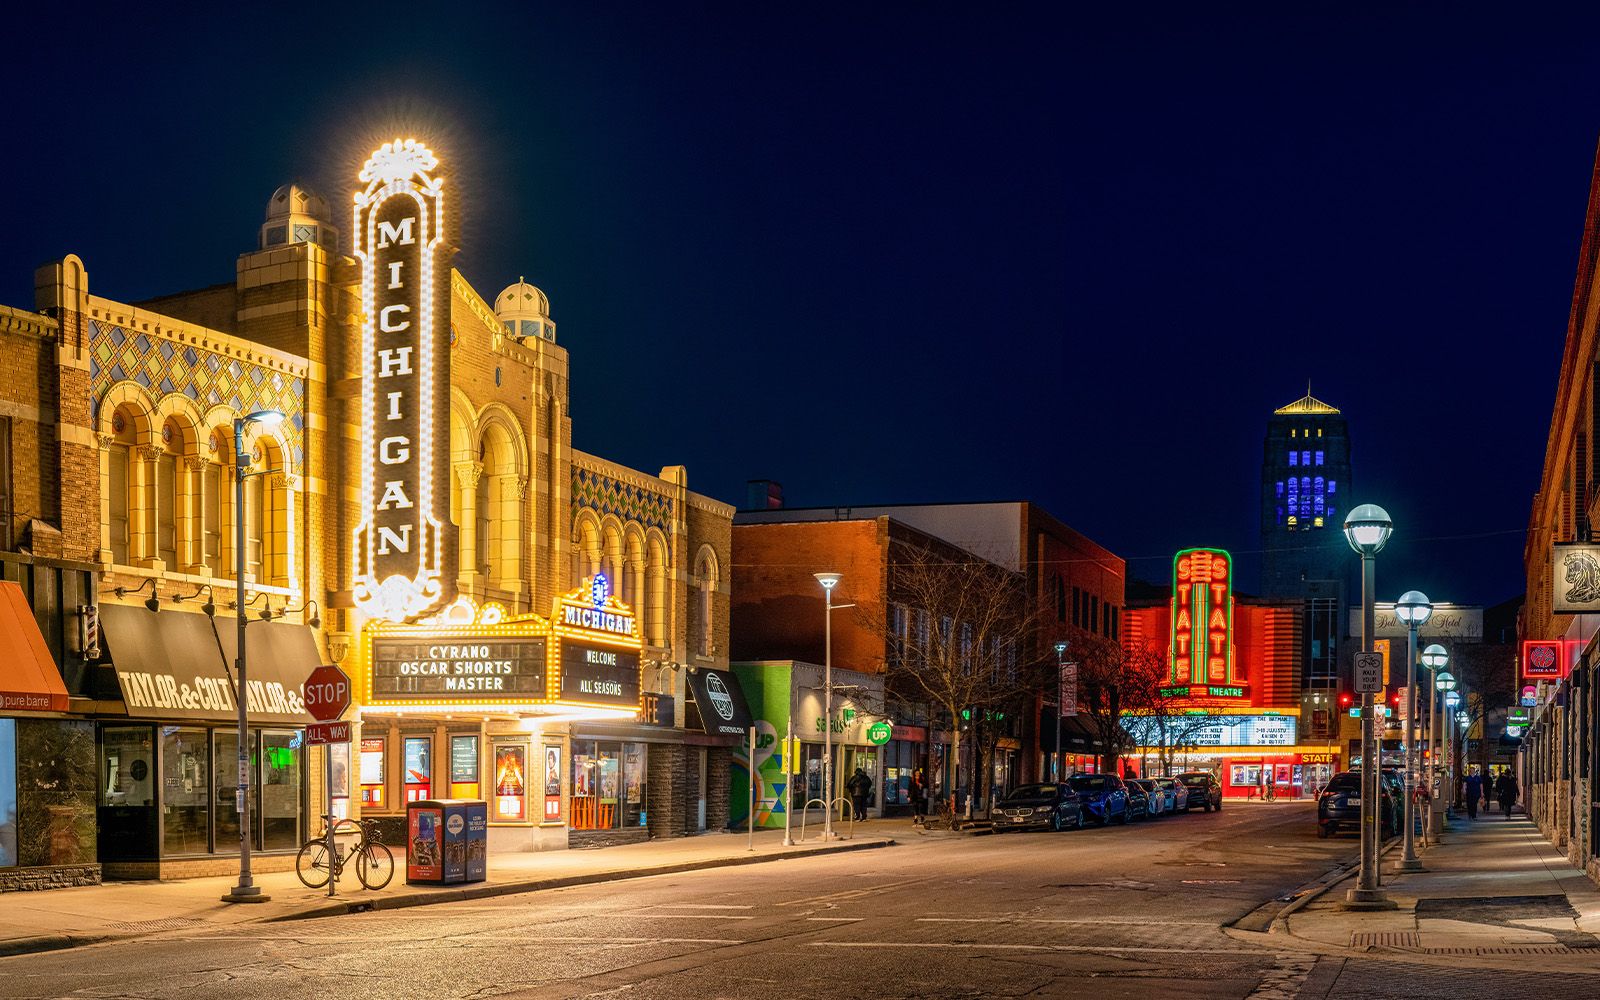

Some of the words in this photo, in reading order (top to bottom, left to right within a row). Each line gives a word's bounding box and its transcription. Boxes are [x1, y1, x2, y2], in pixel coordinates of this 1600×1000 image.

[377, 217, 415, 555] MICHIGAN
[565, 606, 634, 634] MICHIGAN
[1177, 558, 1190, 680] STATE
[1210, 558, 1226, 680] STATE
[1431, 613, 1461, 628] Hotel
[429, 645, 489, 659] CYRANO
[586, 650, 616, 666] WELCOME
[400, 661, 448, 674] OSCAR
[455, 661, 512, 674] SHORTS
[446, 677, 503, 690] MASTER
[580, 680, 593, 693] ALL
[594, 681, 621, 696] SEASONS
[1209, 687, 1242, 696] THEATRE
[307, 682, 346, 704] STOP
[5, 696, 25, 708] pure
[26, 695, 49, 707] barre
[640, 697, 659, 723] AFE
[307, 730, 324, 741] ALL
[330, 725, 348, 739] WAY
[872, 731, 887, 740] UP
[1302, 754, 1333, 763] STATE
